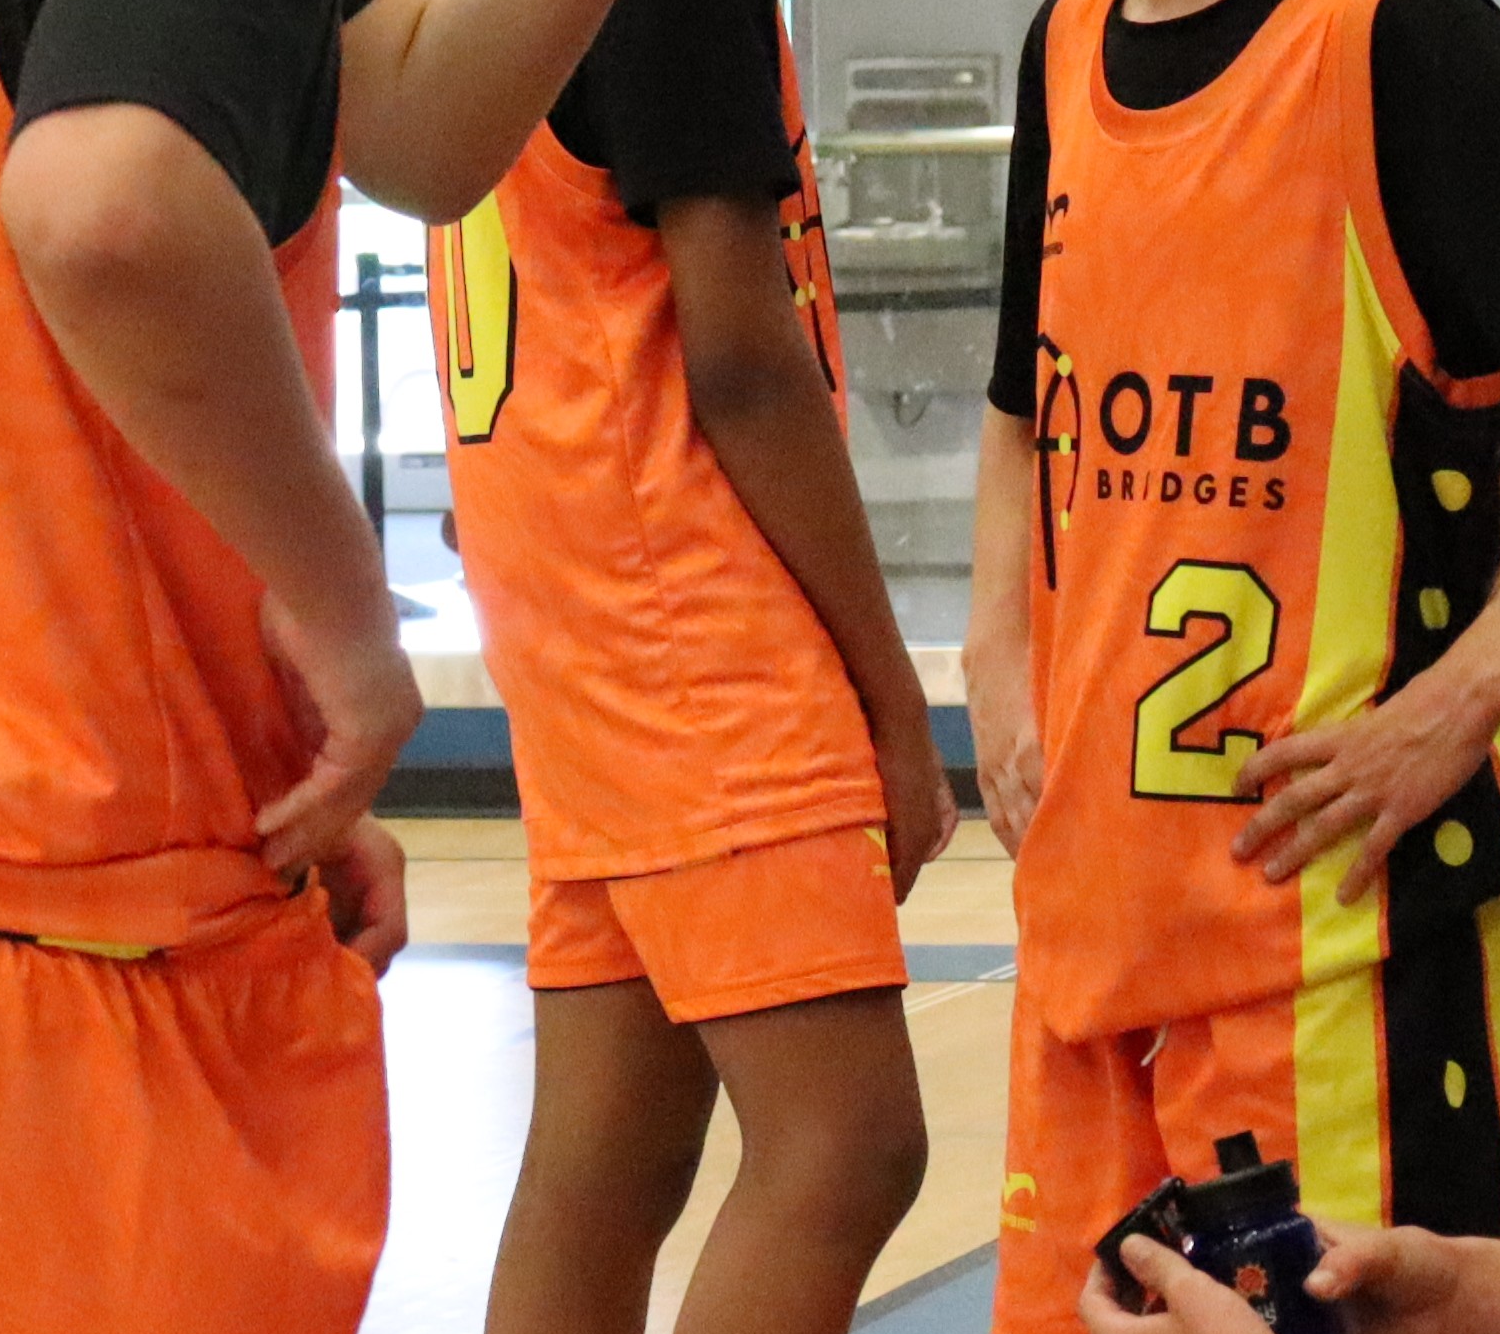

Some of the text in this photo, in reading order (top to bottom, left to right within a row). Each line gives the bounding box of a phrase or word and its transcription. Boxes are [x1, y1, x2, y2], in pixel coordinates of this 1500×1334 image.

[1099, 370, 1292, 462] OTB
[1097, 469, 1287, 511] BRIDGES
[1130, 558, 1280, 804] 2
